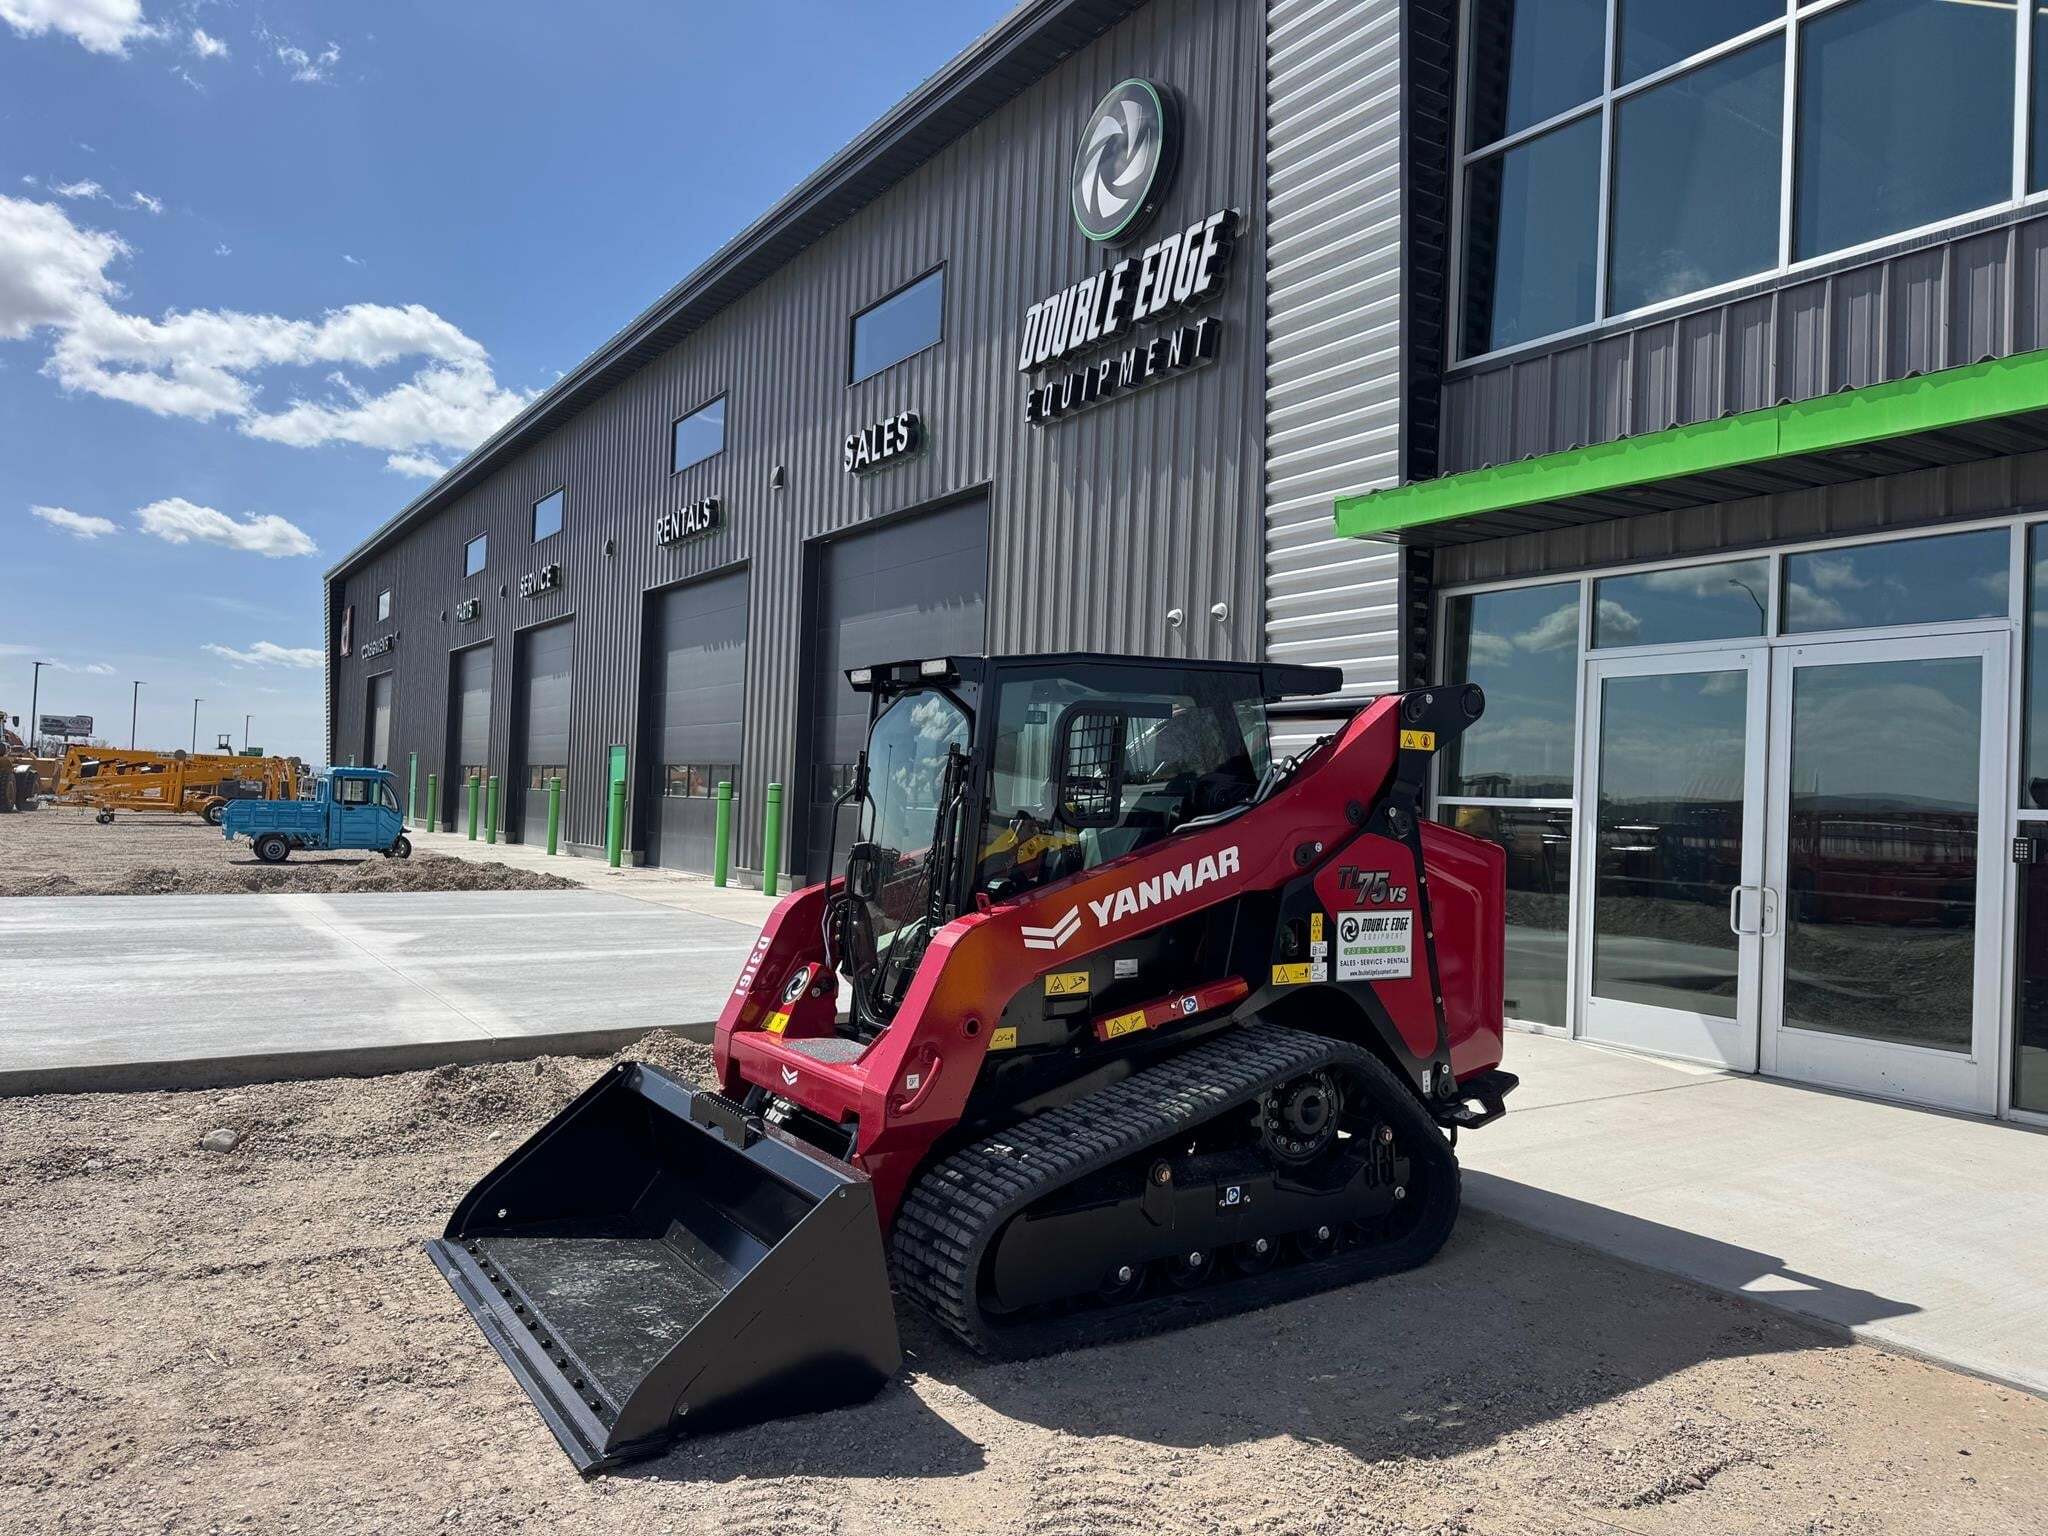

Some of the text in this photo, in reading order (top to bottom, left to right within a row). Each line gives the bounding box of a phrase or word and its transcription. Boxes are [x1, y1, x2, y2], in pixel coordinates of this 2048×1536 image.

[1018, 208, 1227, 372] DOUBLE EDGE
[1024, 317, 1209, 424] EQUIPMENT
[844, 410, 909, 473] SALES
[656, 497, 712, 546] RENTALS
[520, 565, 552, 598] SERVICE
[1088, 846, 1240, 927] YANMAR
[1361, 916, 1410, 932] DOUBLE EDGE
[1340, 959, 1356, 967] SALES
[1360, 958, 1383, 966] SERVICE
